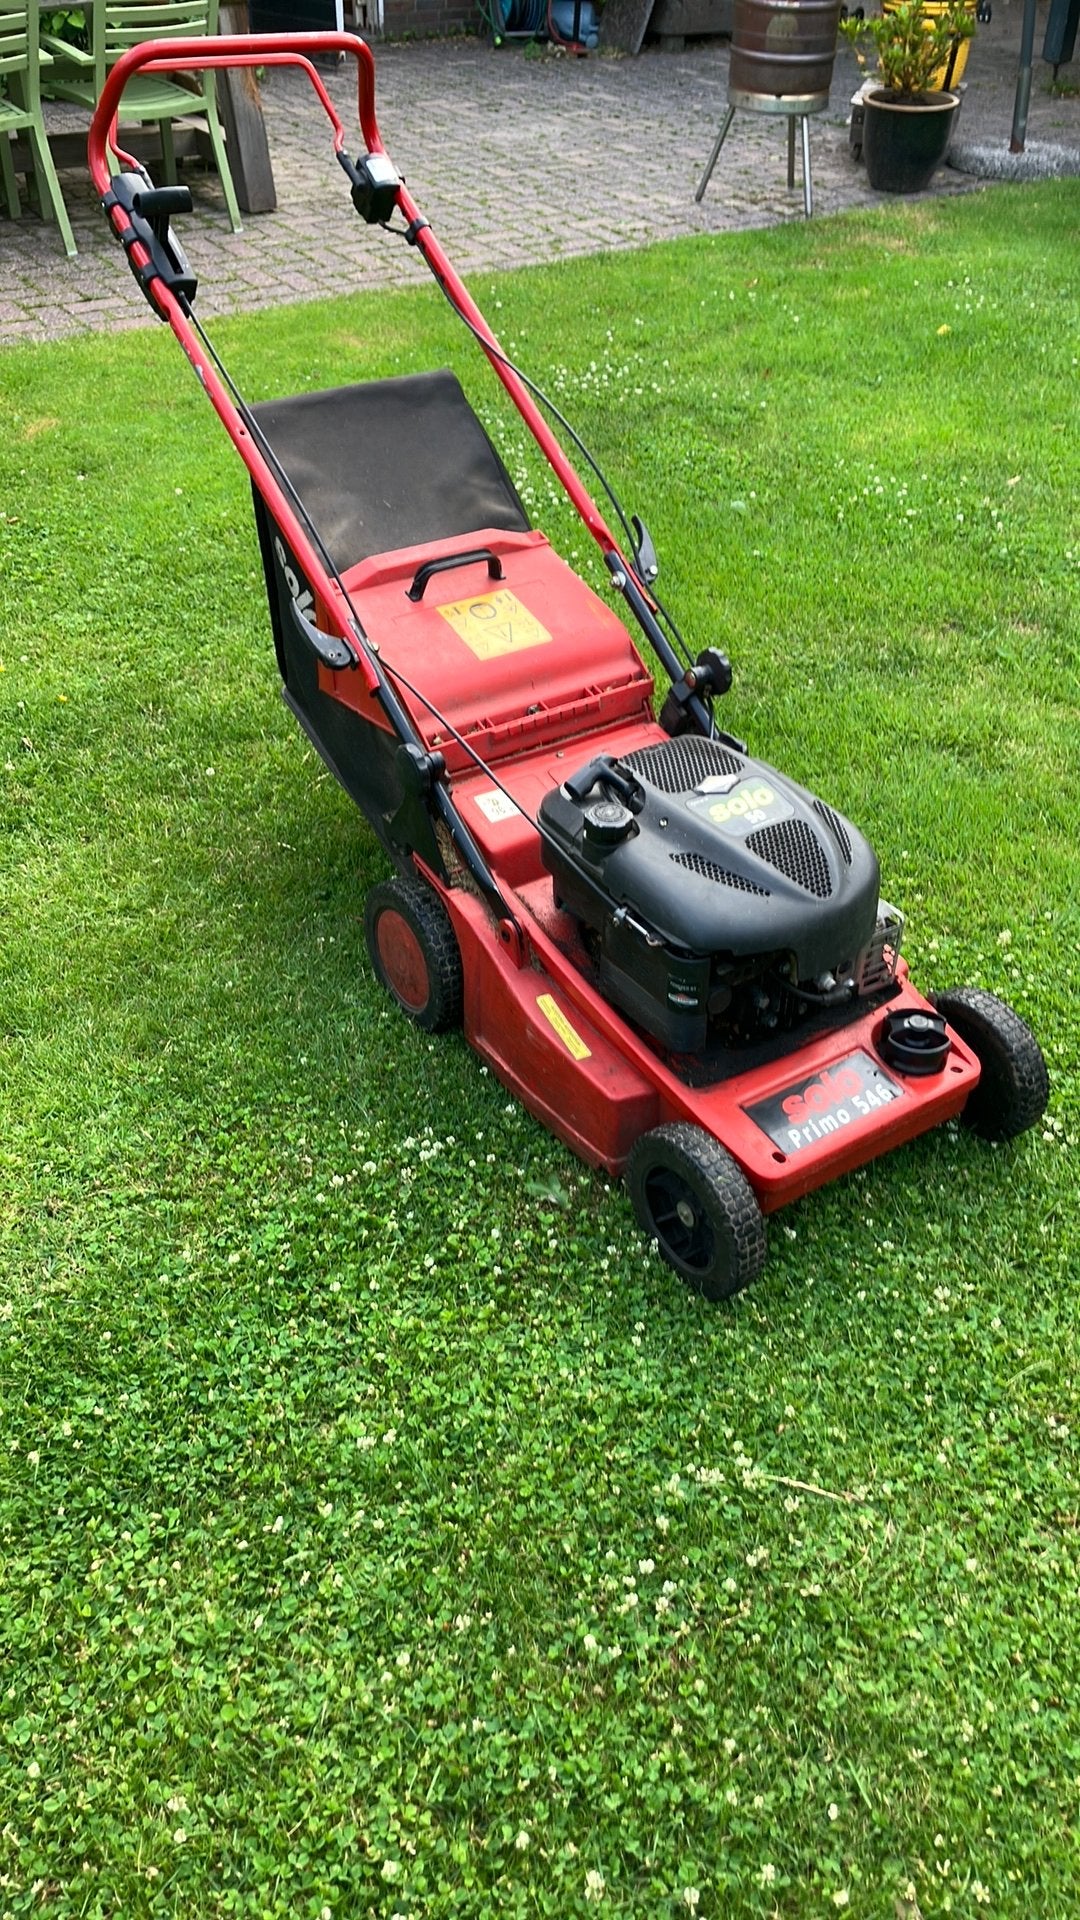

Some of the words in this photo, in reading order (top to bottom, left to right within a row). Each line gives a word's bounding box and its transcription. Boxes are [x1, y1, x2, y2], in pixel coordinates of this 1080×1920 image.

[709, 787, 774, 823] solo
[781, 1067, 864, 1125] solo
[787, 1108, 851, 1149] Primo
[851, 1083, 894, 1115] 546
